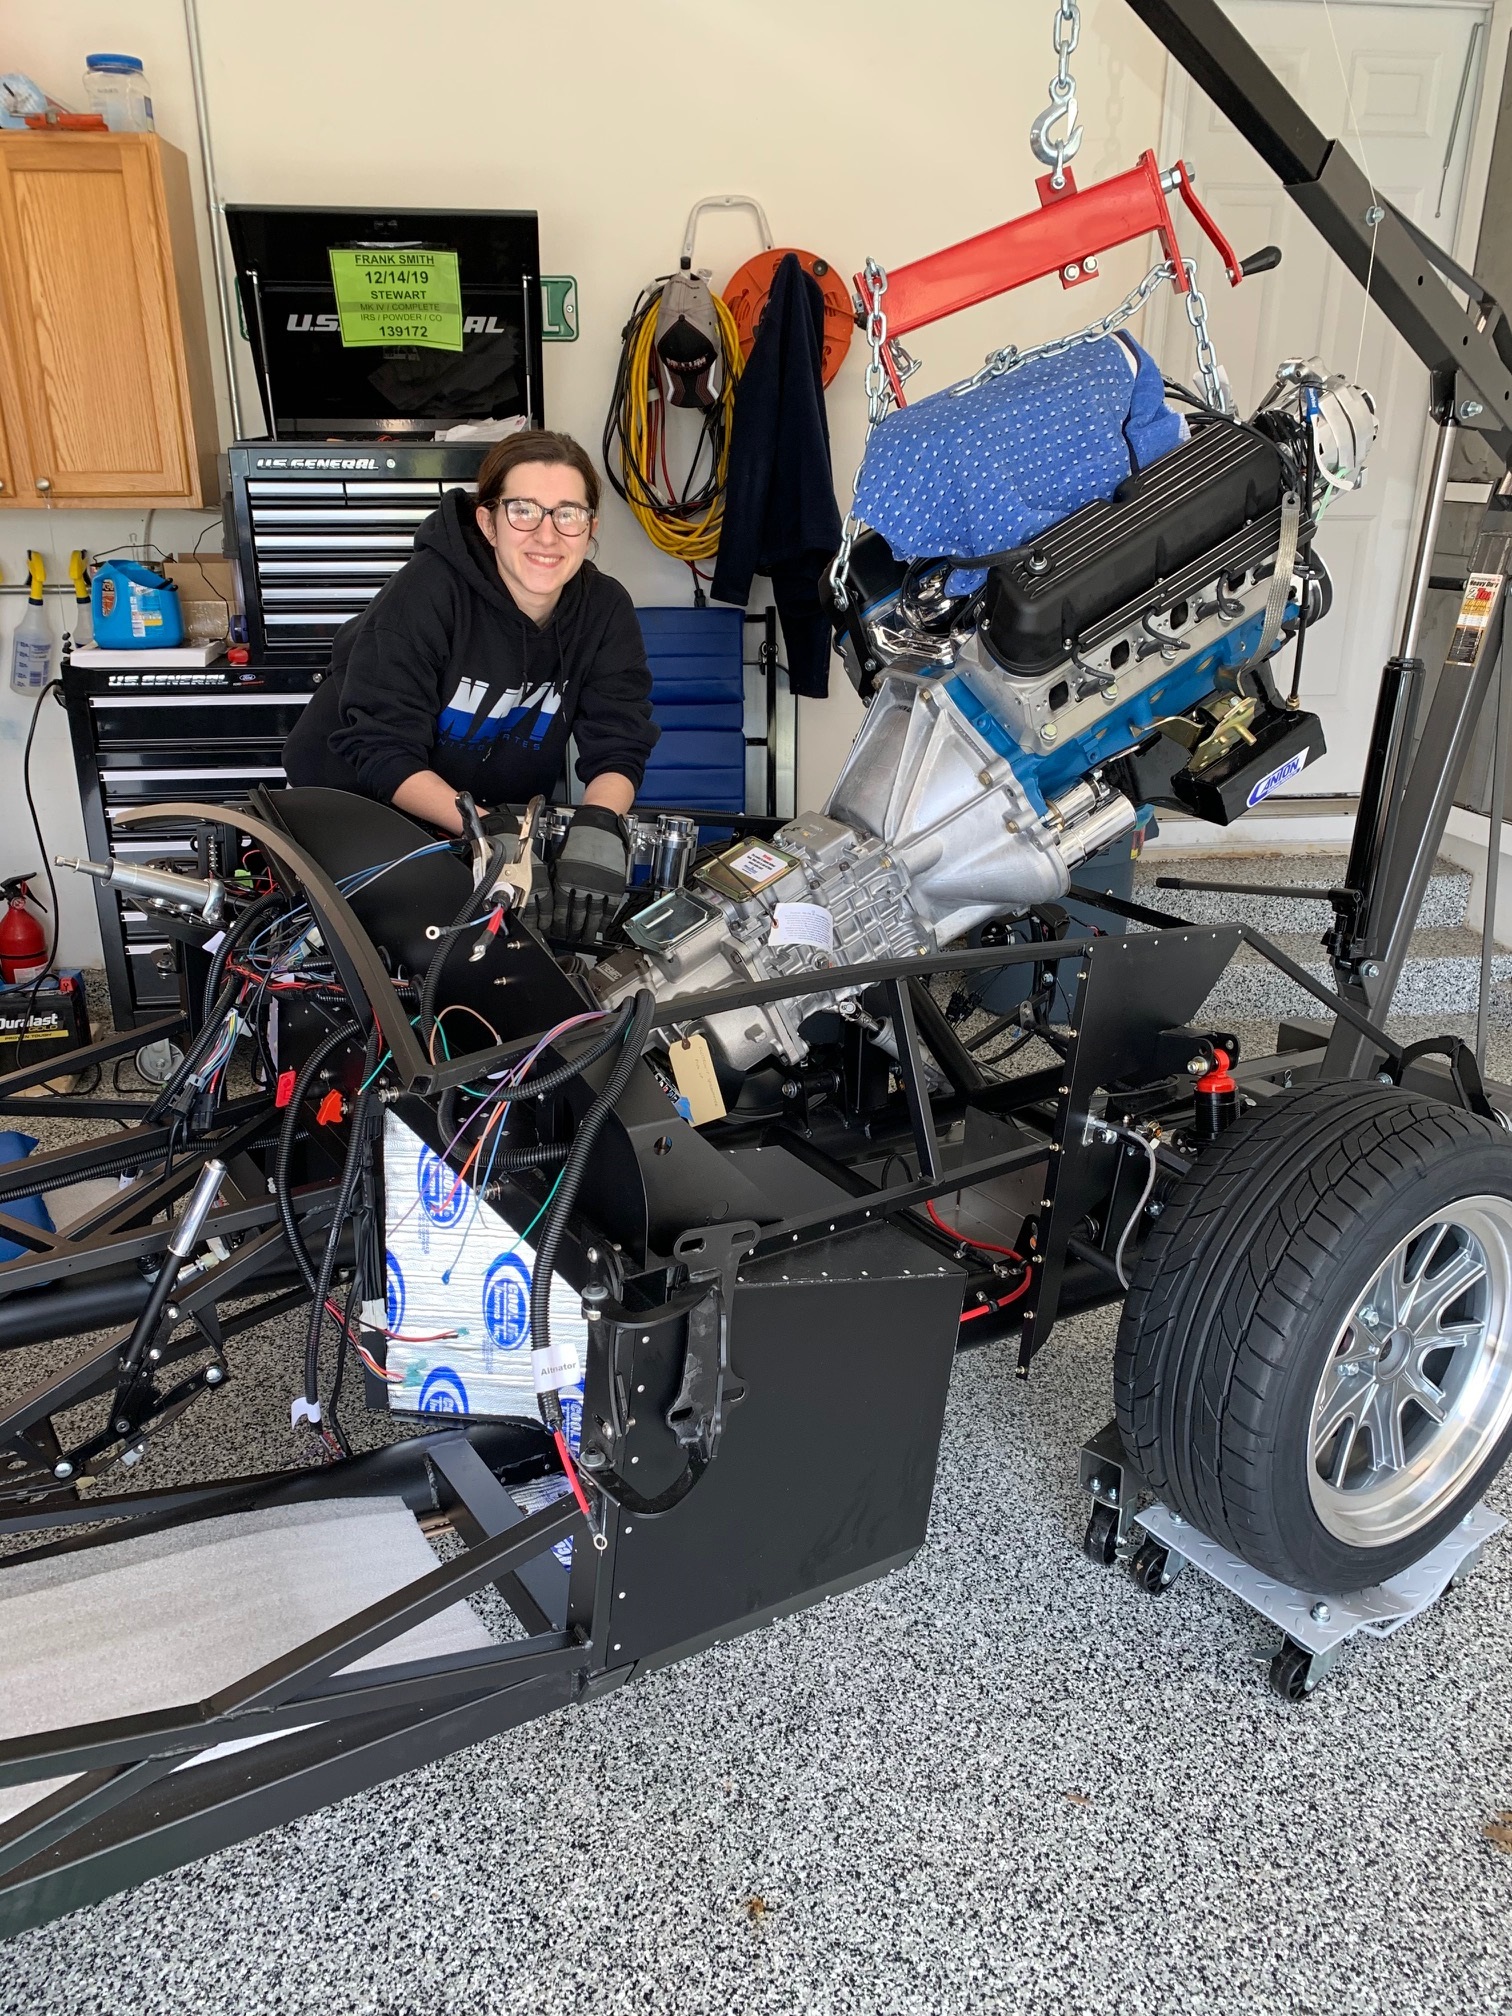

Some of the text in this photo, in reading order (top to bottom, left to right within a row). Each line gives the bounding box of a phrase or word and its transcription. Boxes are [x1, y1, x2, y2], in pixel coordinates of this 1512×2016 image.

[355, 254, 435, 265] FRANK SMITH
[365, 270, 429, 284] 12/14/19
[370, 290, 427, 300] STEWART
[360, 303, 374, 312] MK
[376, 303, 385, 311] IV
[391, 303, 440, 312] COMPLETE
[360, 313, 376, 321] IRS
[382, 313, 422, 321] POWDER
[428, 314, 443, 322] CO
[379, 326, 428, 338] 139172
[290, 458, 379, 470] GENERAL
[1466, 587, 1478, 600] 2
[141, 674, 229, 686] GENERAL
[1249, 755, 1301, 806] CANTON
[28, 1024, 59, 1032] GOLD
[507, 1283, 519, 1321] COOL
[570, 1403, 582, 1439] COOL
